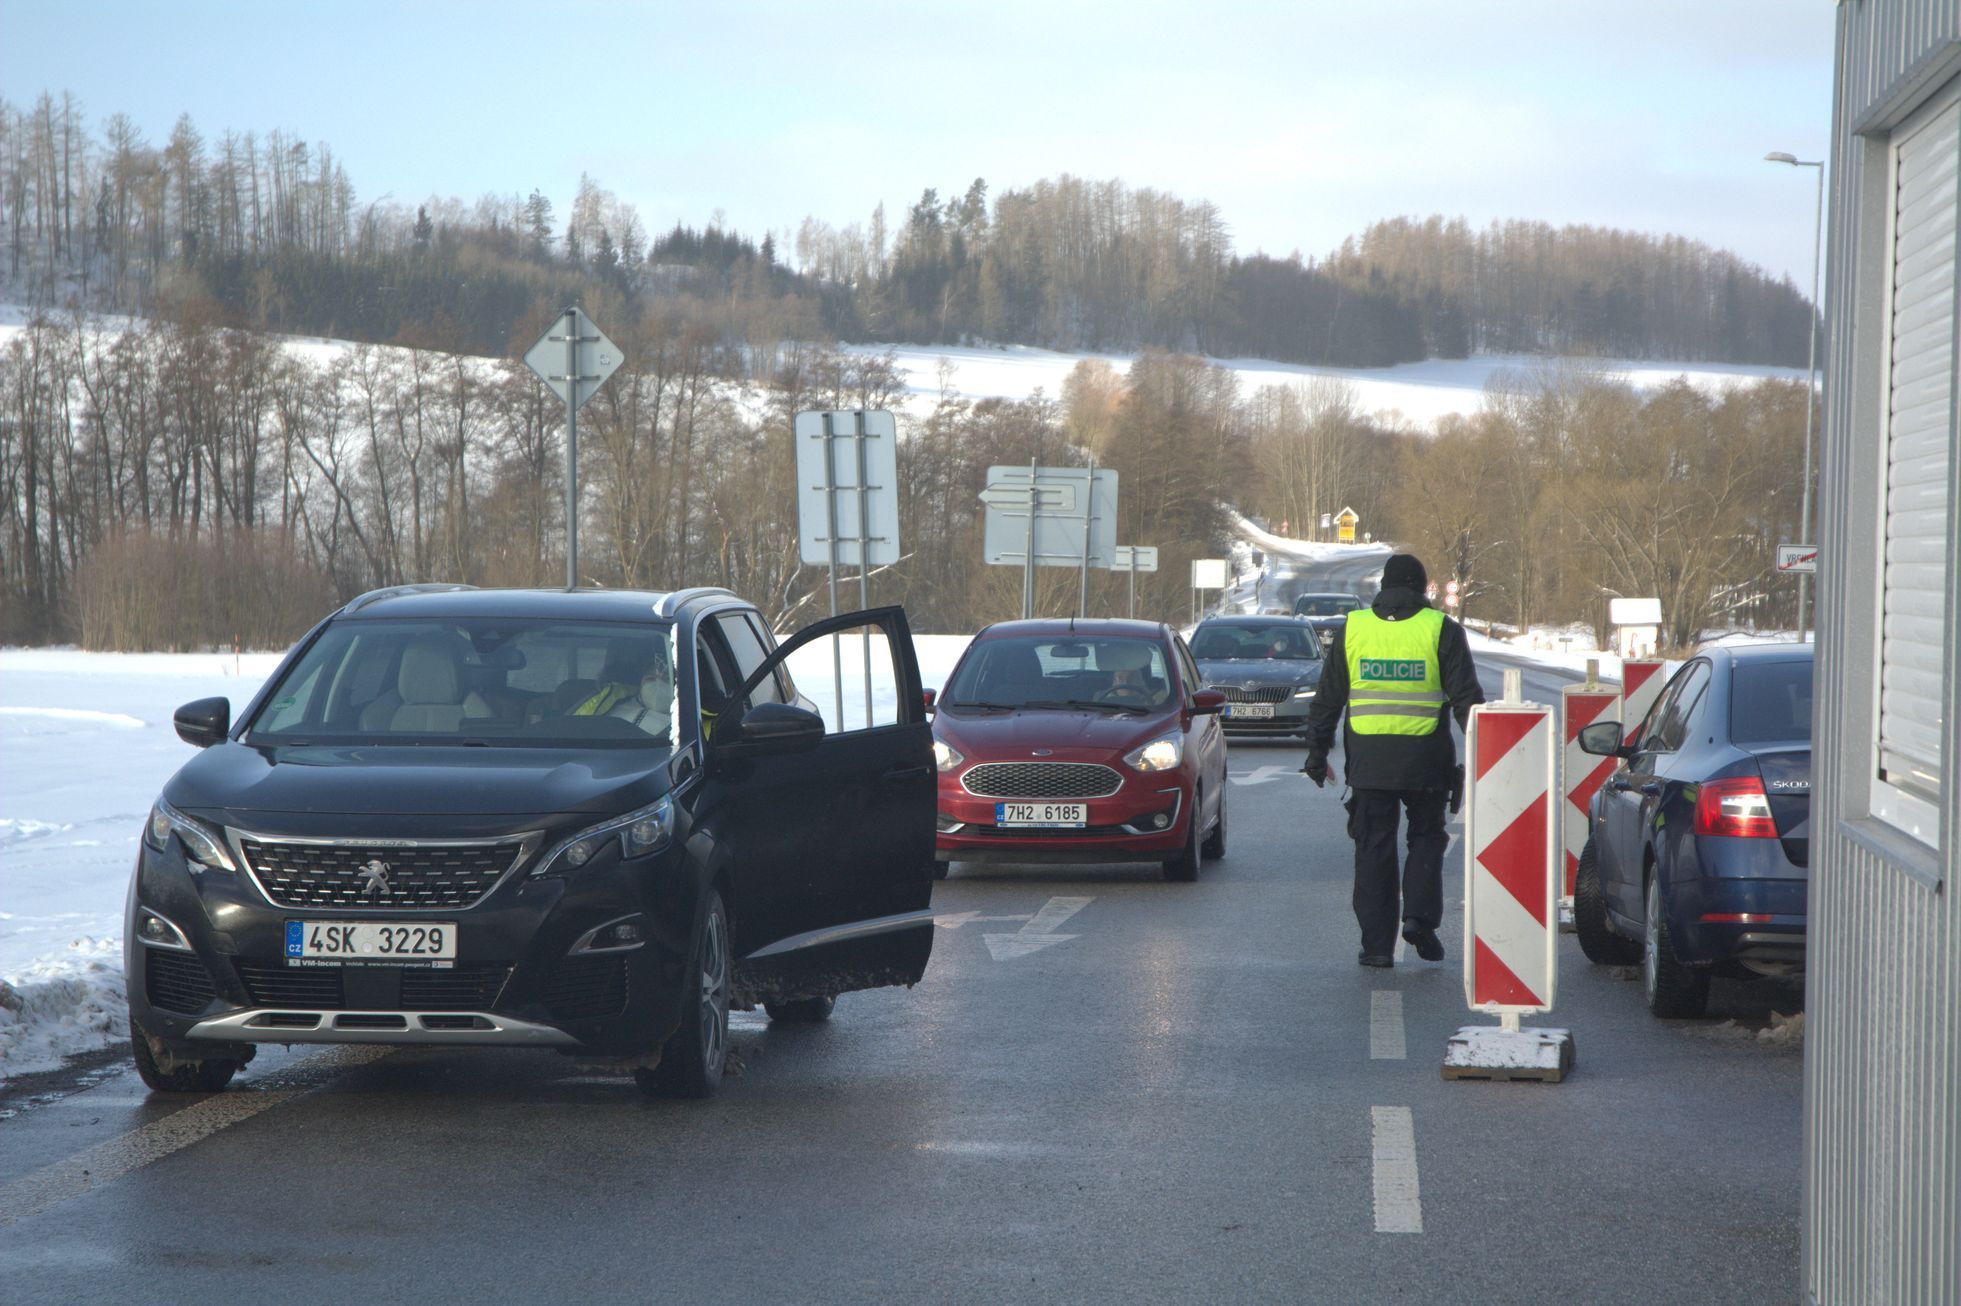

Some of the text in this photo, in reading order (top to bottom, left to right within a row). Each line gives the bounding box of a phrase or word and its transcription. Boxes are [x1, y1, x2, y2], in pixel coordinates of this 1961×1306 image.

[1361, 662, 1424, 678] POLICIE
[1232, 707, 1271, 716] 7H2 6766
[1008, 806, 1080, 820] 7H2 6185
[309, 926, 443, 954] 4SK 3229
[288, 944, 301, 953] CZ
